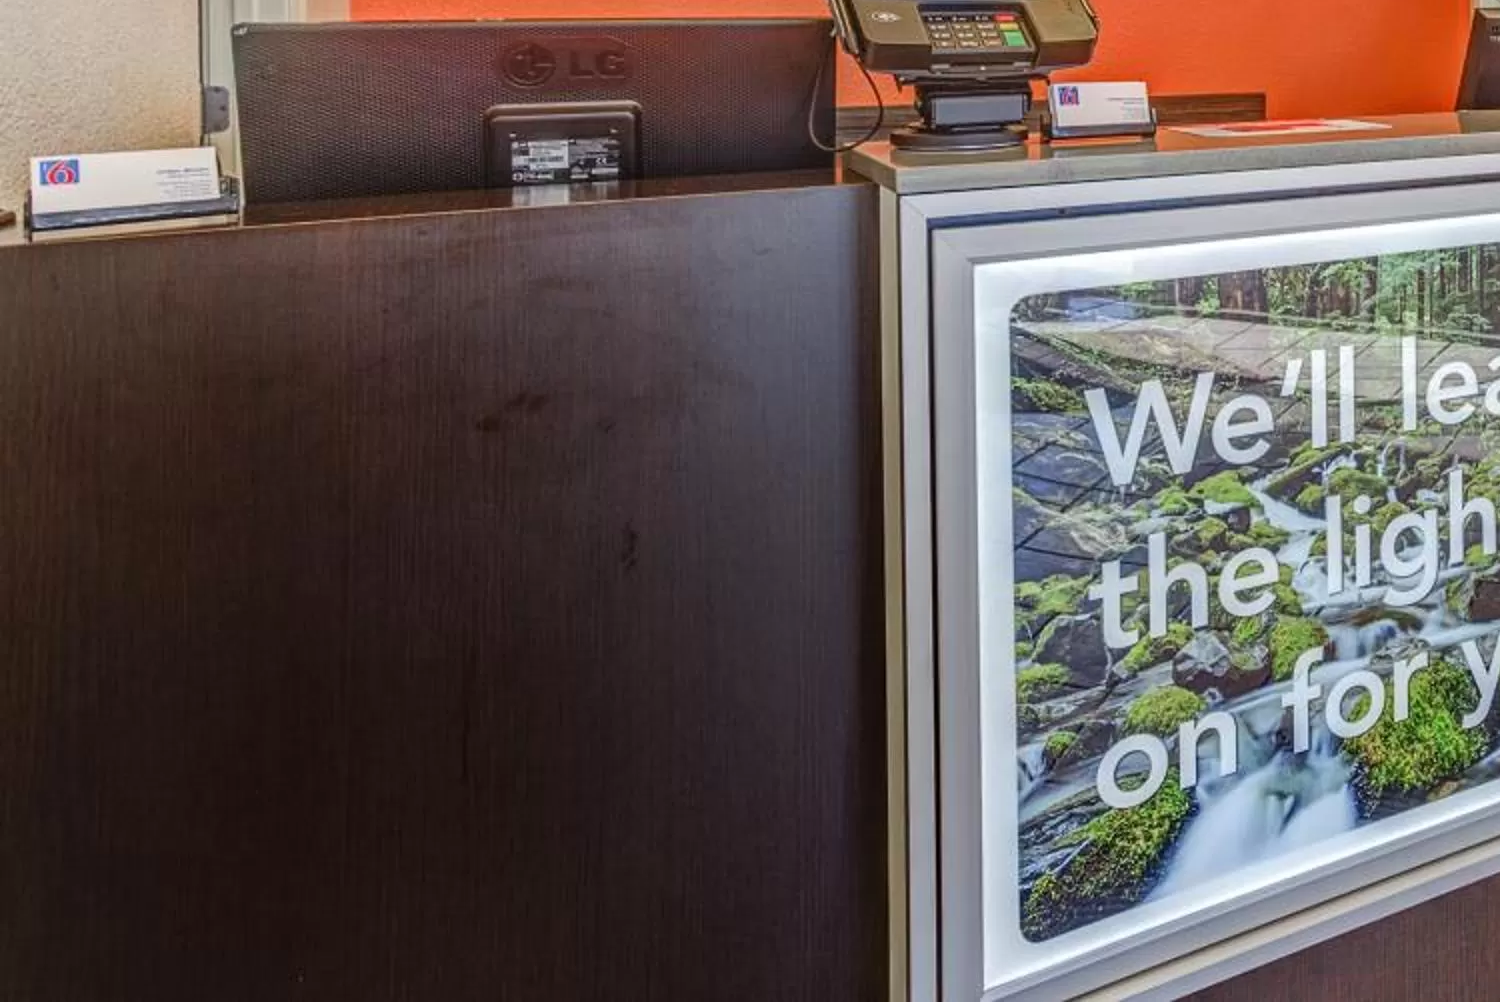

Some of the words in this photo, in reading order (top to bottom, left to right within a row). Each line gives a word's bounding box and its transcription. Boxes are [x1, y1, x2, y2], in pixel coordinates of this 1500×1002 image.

[569, 49, 626, 78] LG
[1085, 345, 1356, 486] We'll
[1091, 533, 1280, 651] the
[1096, 710, 1238, 809] on
[1281, 645, 1431, 754] for
